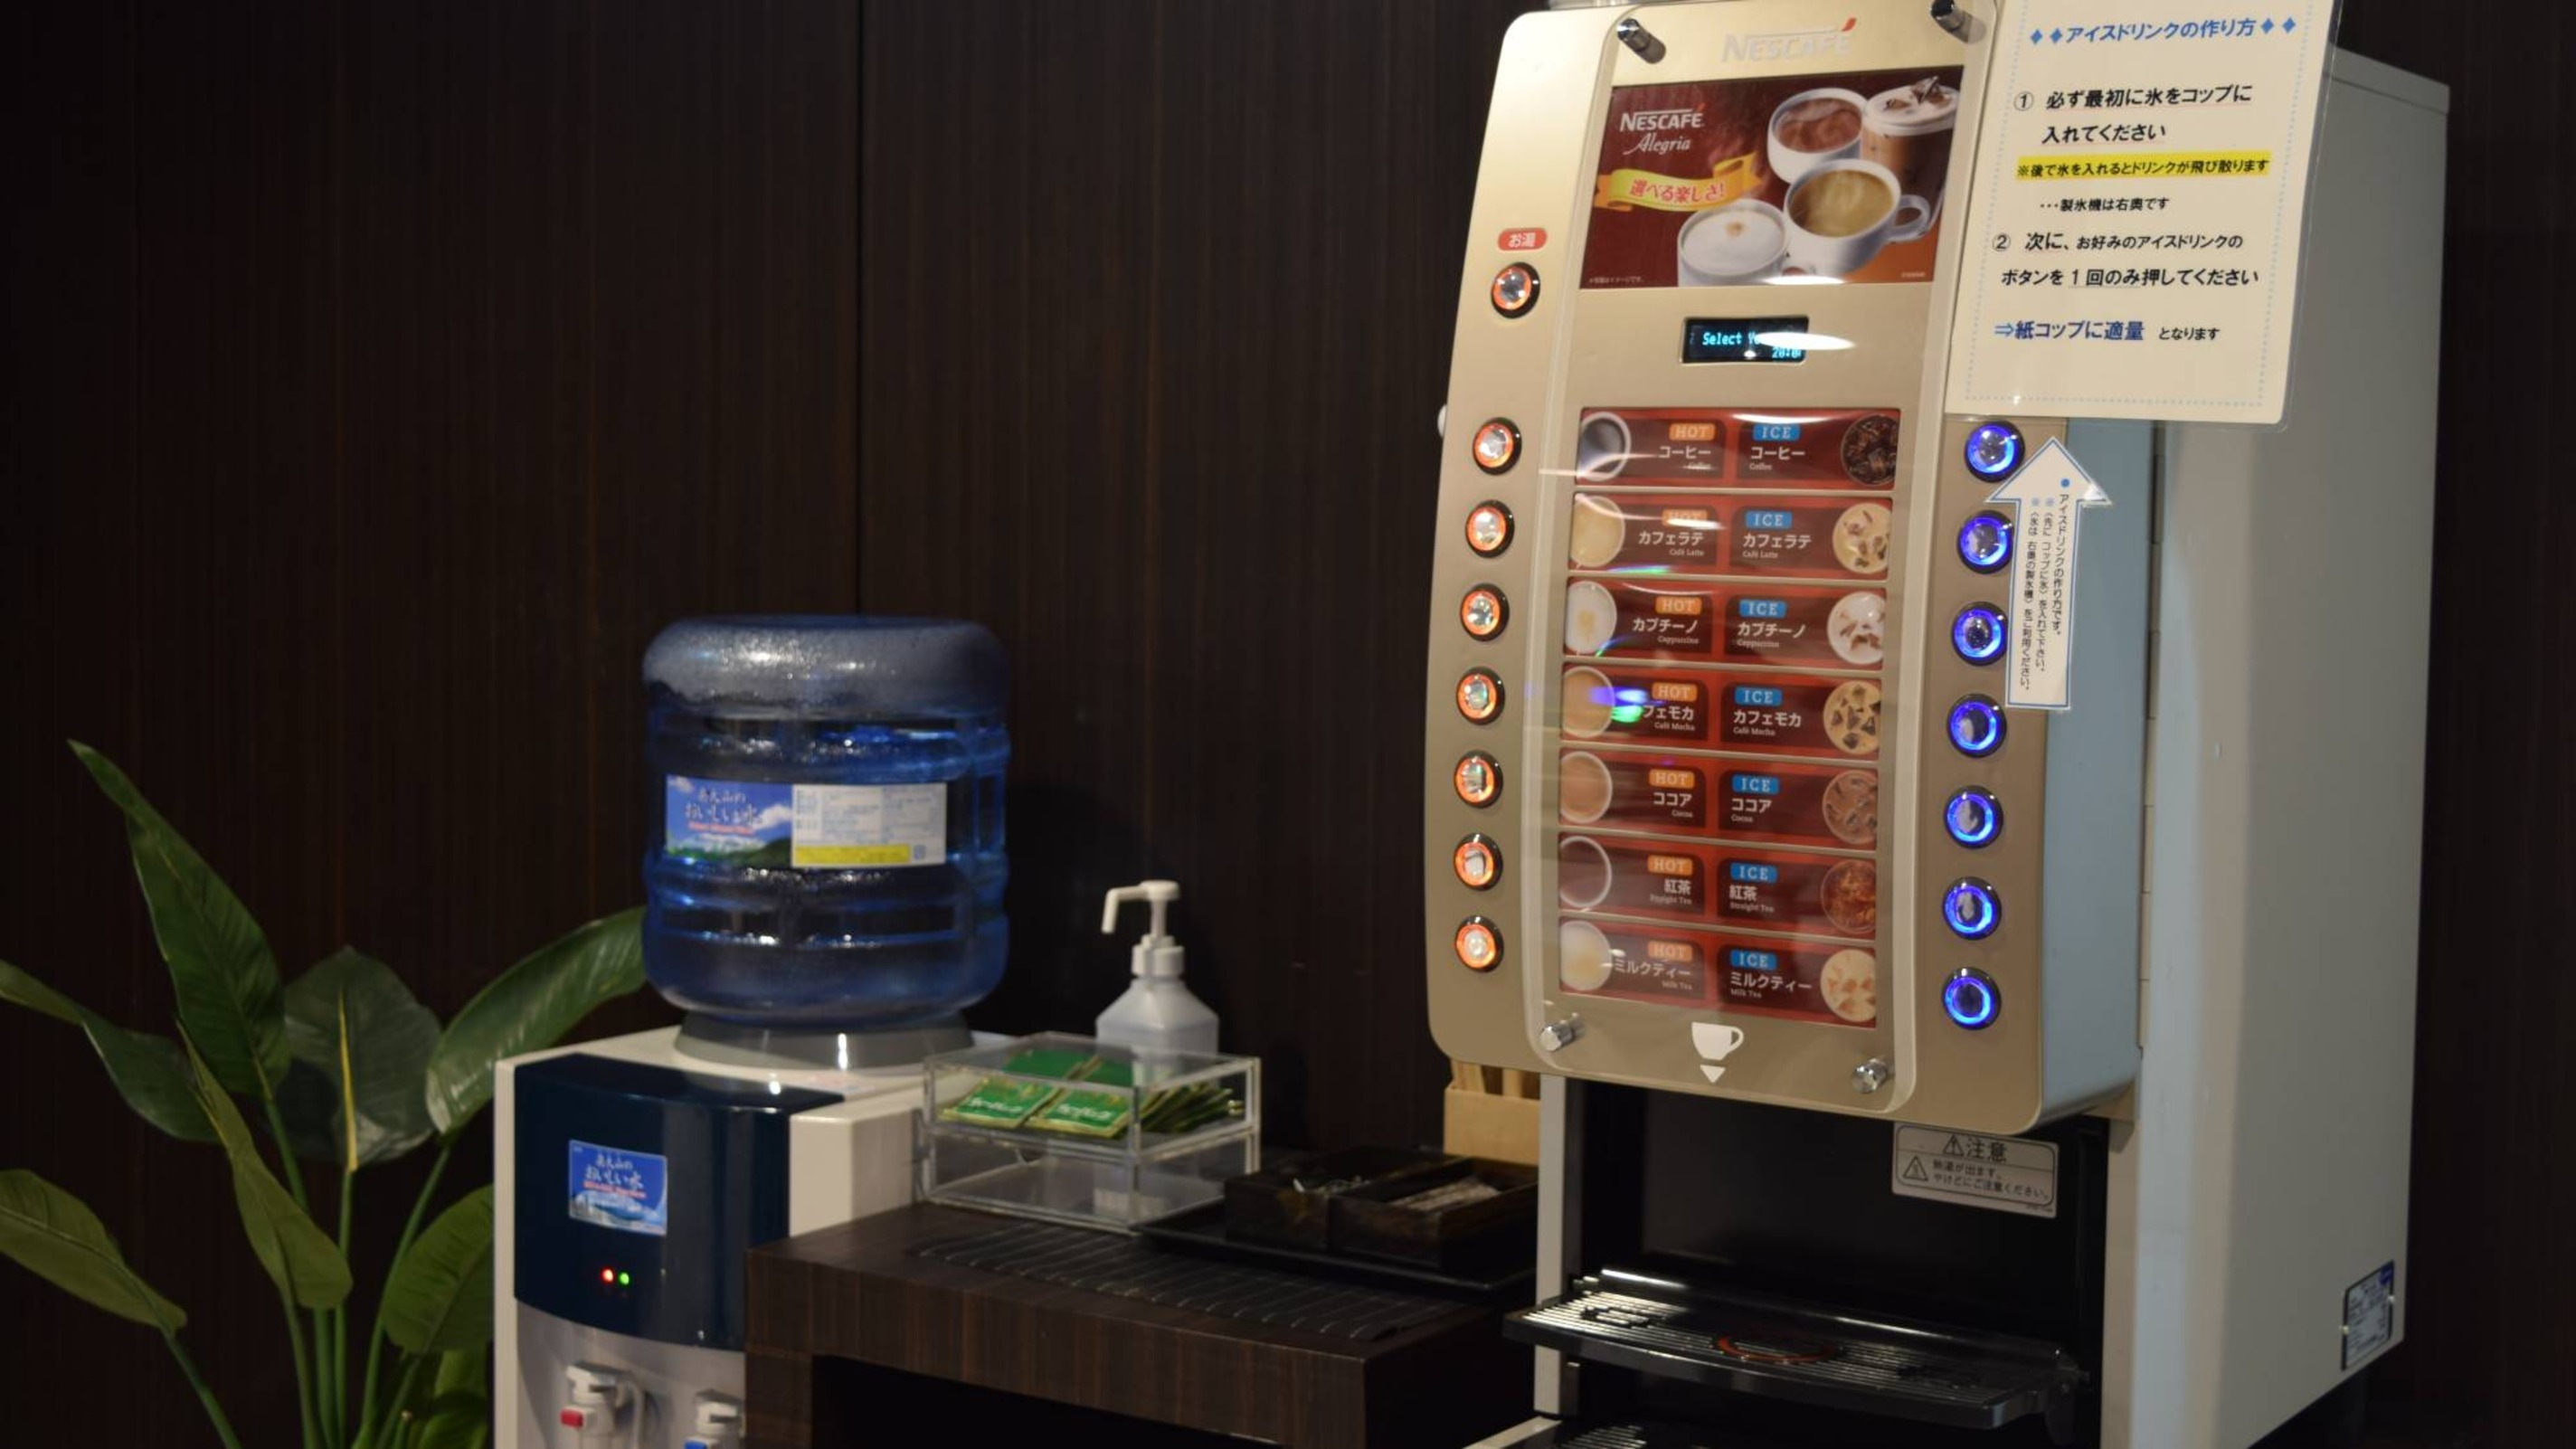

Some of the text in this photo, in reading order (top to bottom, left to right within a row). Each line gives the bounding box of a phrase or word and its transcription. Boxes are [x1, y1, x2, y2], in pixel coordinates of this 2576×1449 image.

[2066, 19, 2257, 43] アイスドリンクの作り方
[2046, 85, 2253, 109] 必ず最初に氷をコップに
[2041, 124, 2166, 144] 入れてください
[1623, 132, 1691, 155] Alegria
[1508, 232, 1536, 248] お湯
[1701, 332, 1743, 346] Select
[2159, 327, 2220, 340] となります
[1675, 424, 1709, 439] HOT
[1762, 425, 1792, 440] ICE
[1659, 445, 1711, 459] コーヒー
[1751, 446, 1805, 460] コーヒー
[1753, 514, 1784, 526] ICE
[1638, 530, 1705, 546] カフェラテ
[1742, 533, 1812, 550] カフェラテ
[1662, 598, 1696, 612] HOT
[1748, 602, 1778, 616] ICE
[1632, 618, 1699, 633] カプチーノ
[1738, 621, 1806, 639] カプチーノ
[1657, 635, 1699, 646] Cappuccino
[1658, 685, 1691, 699] HOT
[1744, 689, 1774, 704] ICE
[1642, 705, 1694, 721] フェモカ
[1733, 710, 1802, 728] カフェモカ
[1655, 772, 1689, 786] HOT
[1741, 777, 1771, 792] ICE
[1653, 791, 1693, 808] ココア
[1731, 798, 1773, 814] ココア
[1653, 857, 1686, 872] HOT
[1739, 866, 1768, 881] ICE
[1664, 878, 1691, 895] 紅茶
[1729, 885, 1757, 902] 紅茶
[1654, 944, 1686, 959] HOT
[1739, 952, 1769, 968] ICE
[1615, 959, 1691, 979] ミルクティー
[1730, 971, 1813, 992] ミルクティー
[1965, 1137, 2008, 1163] 注意
